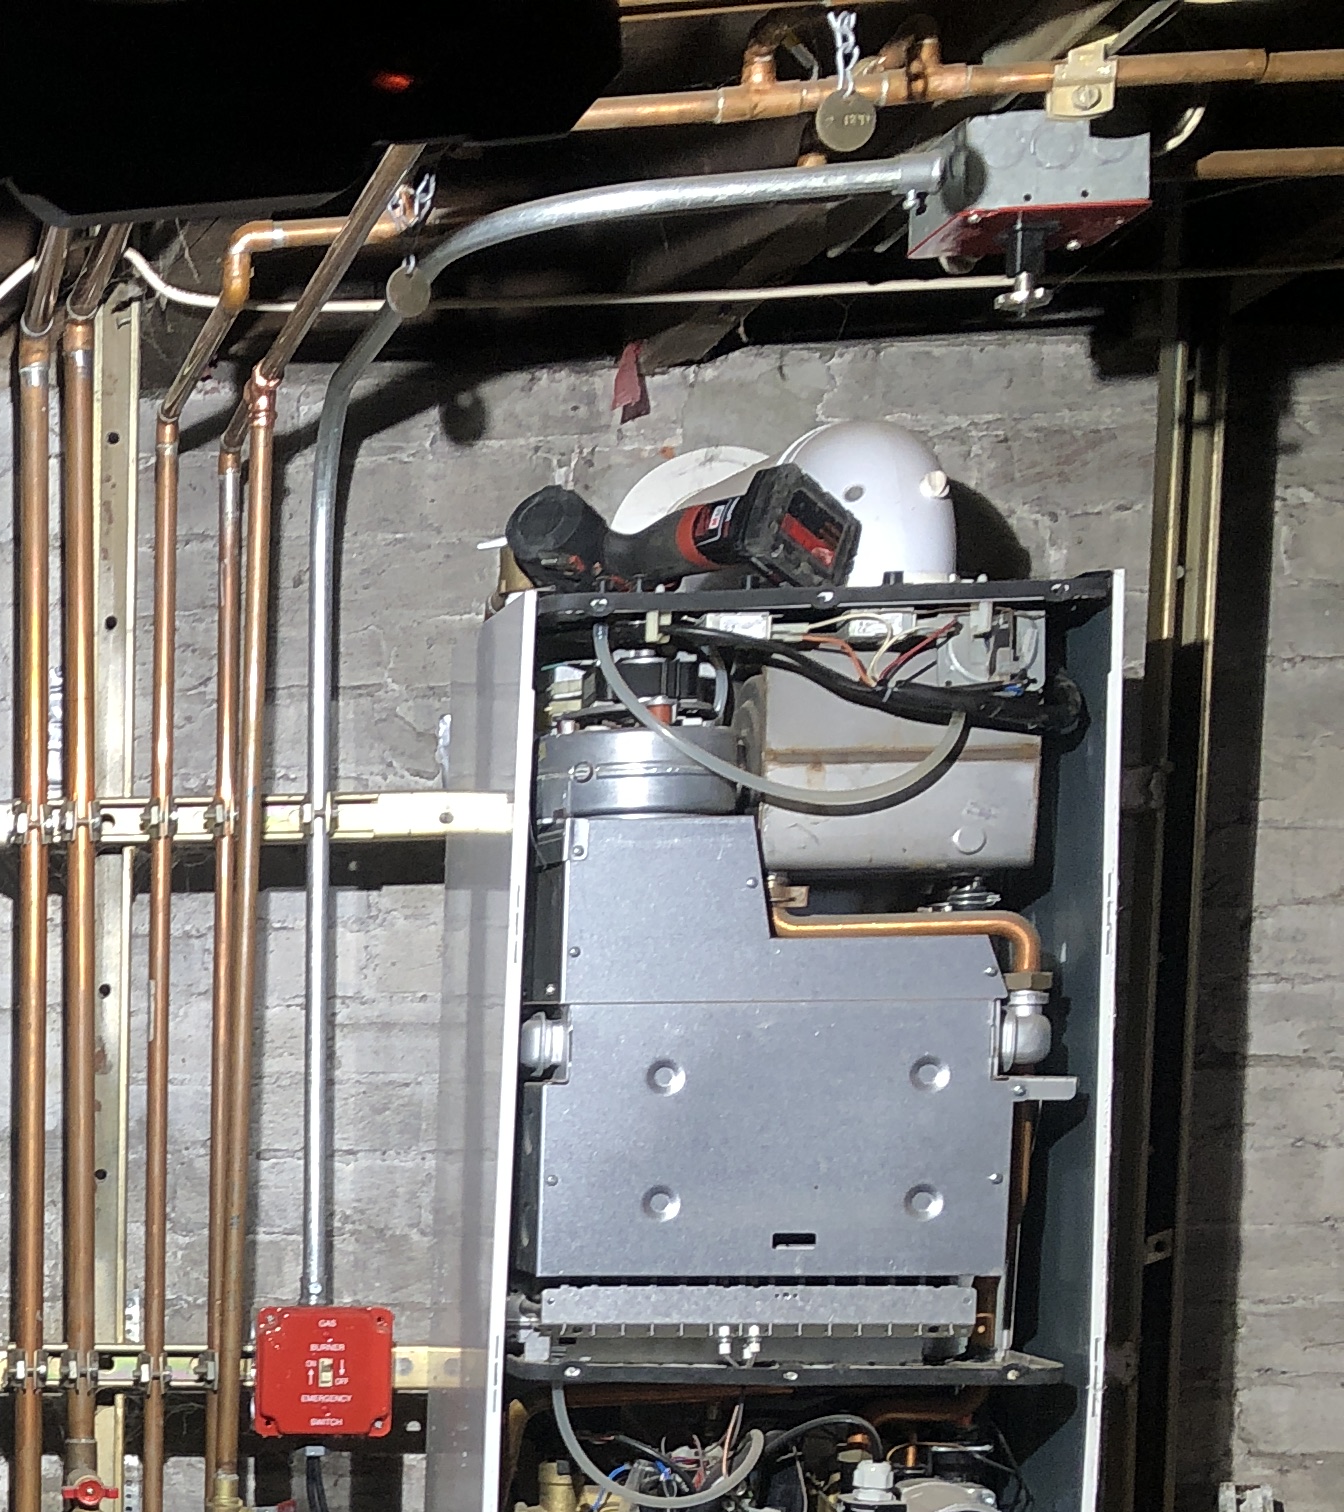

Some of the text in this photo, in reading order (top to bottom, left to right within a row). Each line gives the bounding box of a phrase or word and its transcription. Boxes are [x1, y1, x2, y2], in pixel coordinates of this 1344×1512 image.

[318, 1319, 337, 1327] GAS
[310, 1343, 345, 1351] BURNER
[300, 1394, 353, 1402] EMERGENCY
[310, 1418, 343, 1426] SWITCH
